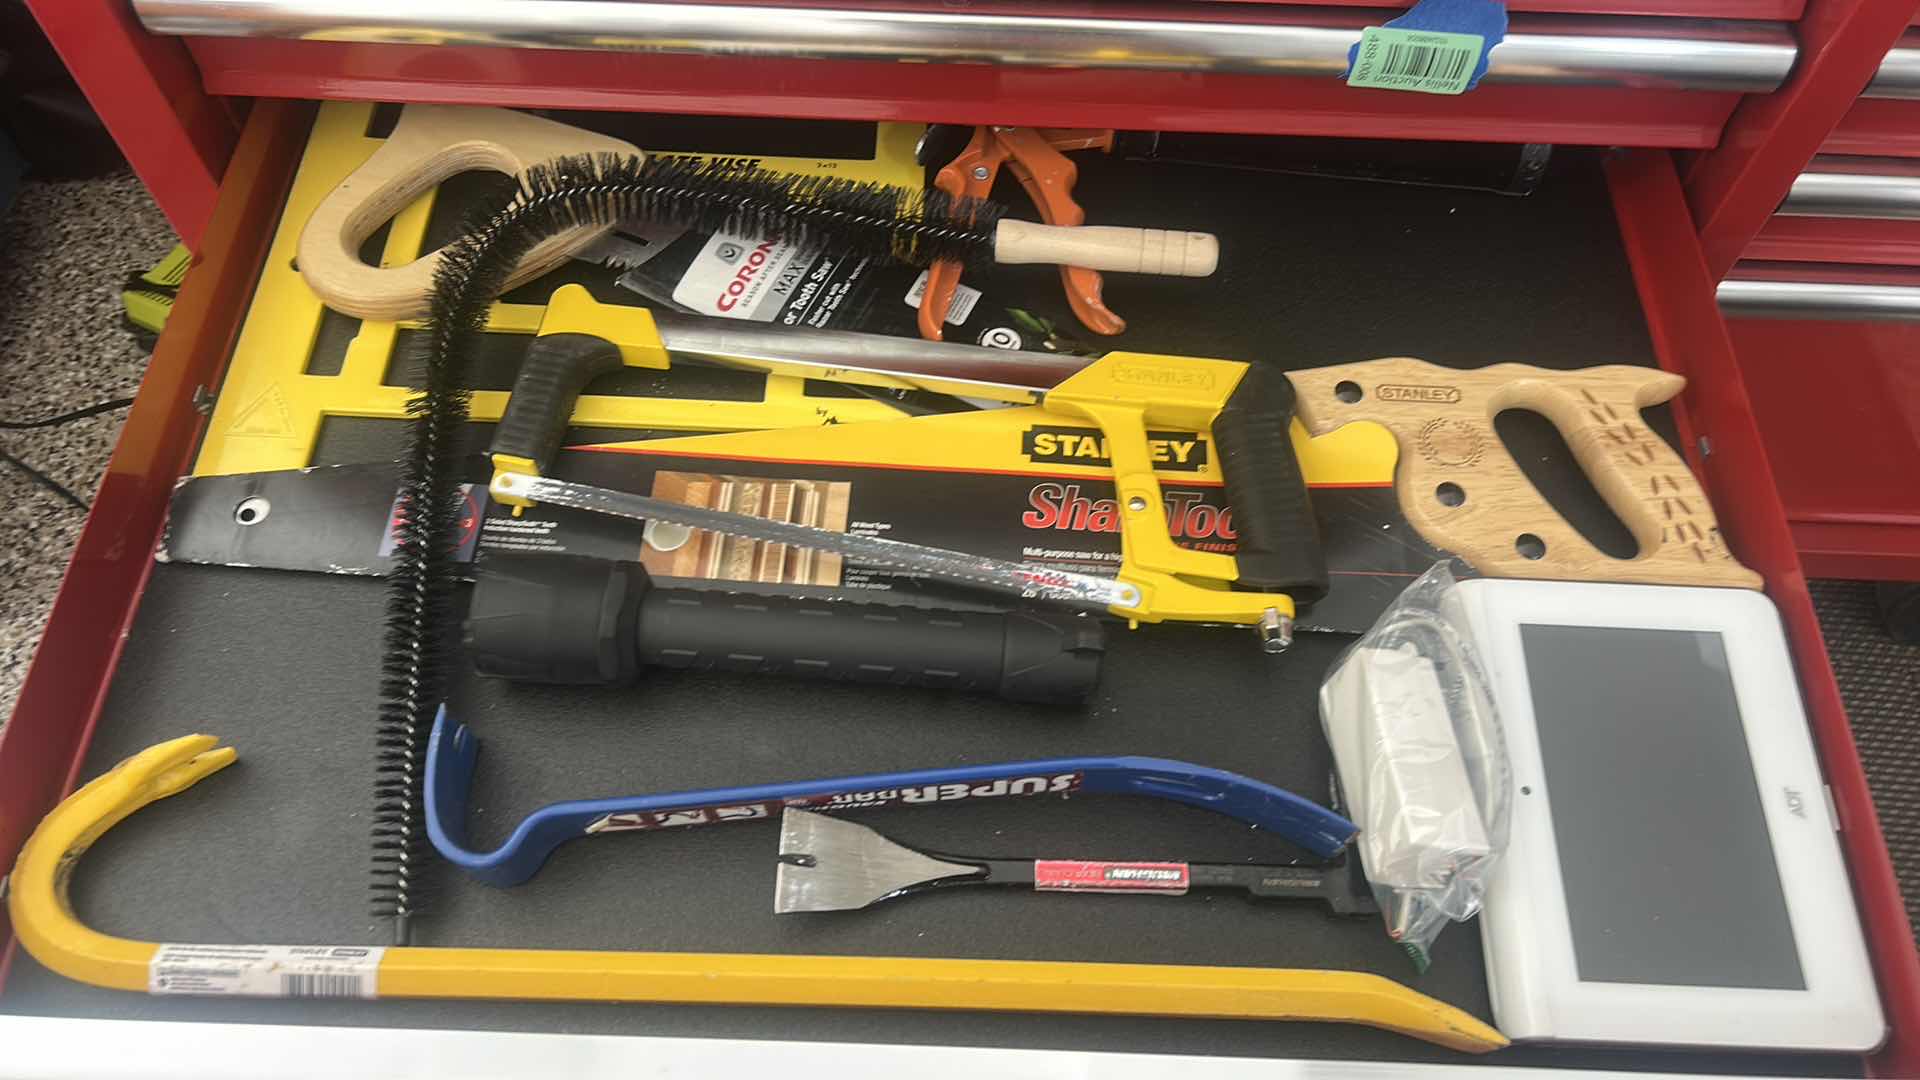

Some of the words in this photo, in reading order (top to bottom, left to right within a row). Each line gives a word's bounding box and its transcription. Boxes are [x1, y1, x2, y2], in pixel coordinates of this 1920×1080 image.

[1375, 73, 1424, 87] Auction
[1426, 77, 1461, 91] Nellis
[716, 237, 779, 313] CORON
[771, 262, 805, 295] MAX
[789, 281, 818, 310] Tooth
[809, 260, 834, 281] Saw
[1382, 387, 1456, 400] STANLEY
[1022, 547, 1074, 559] Multi-purpose
[1091, 551, 1103, 560] for
[1194, 542, 1237, 552] FINIS
[901, 774, 1074, 803] SUPER
[829, 789, 896, 804] BAR
[1782, 786, 1808, 819] ADT
